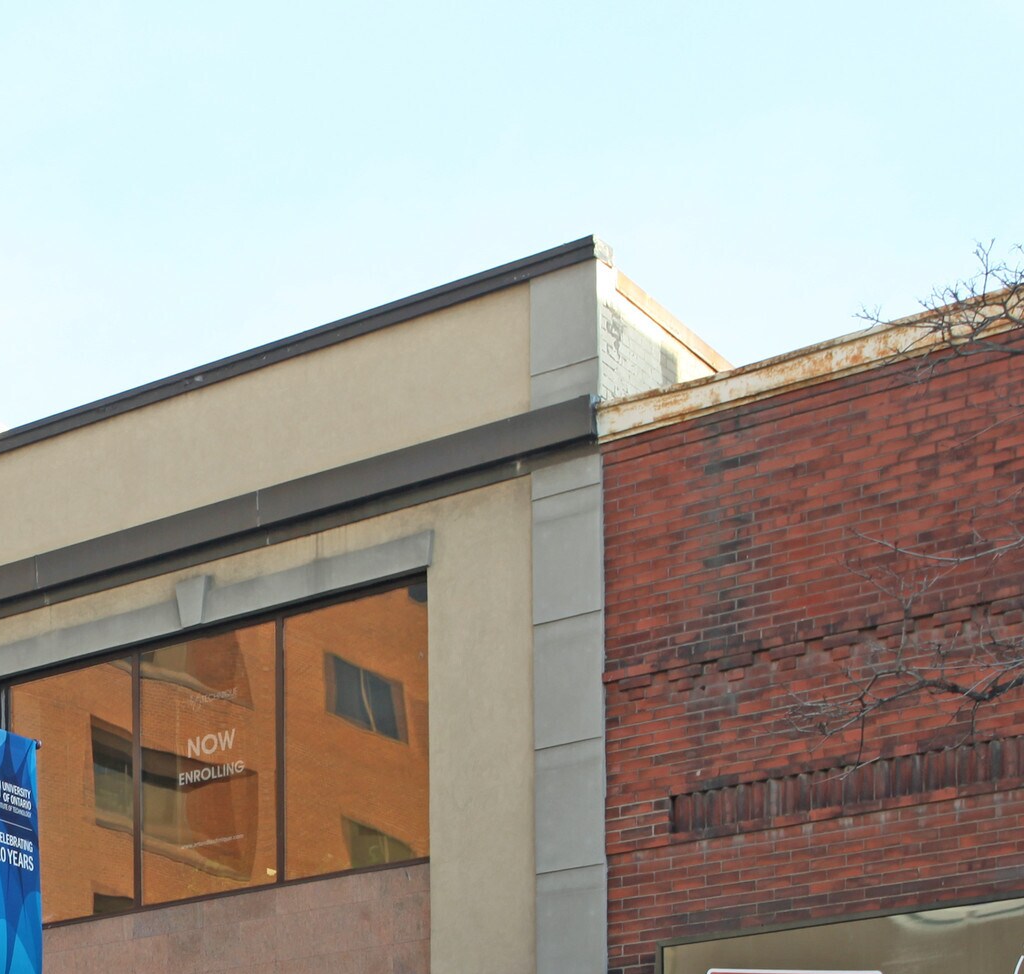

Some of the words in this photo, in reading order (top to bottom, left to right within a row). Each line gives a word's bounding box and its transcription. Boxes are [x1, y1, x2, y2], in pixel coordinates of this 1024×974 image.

[187, 728, 236, 759] NOW
[178, 760, 245, 786] ENROLLING
[1, 781, 31, 799] UNIVERSITY
[2, 792, 10, 802] OF
[10, 793, 32, 810] ONTARIO
[7, 848, 34, 871] YEARS
